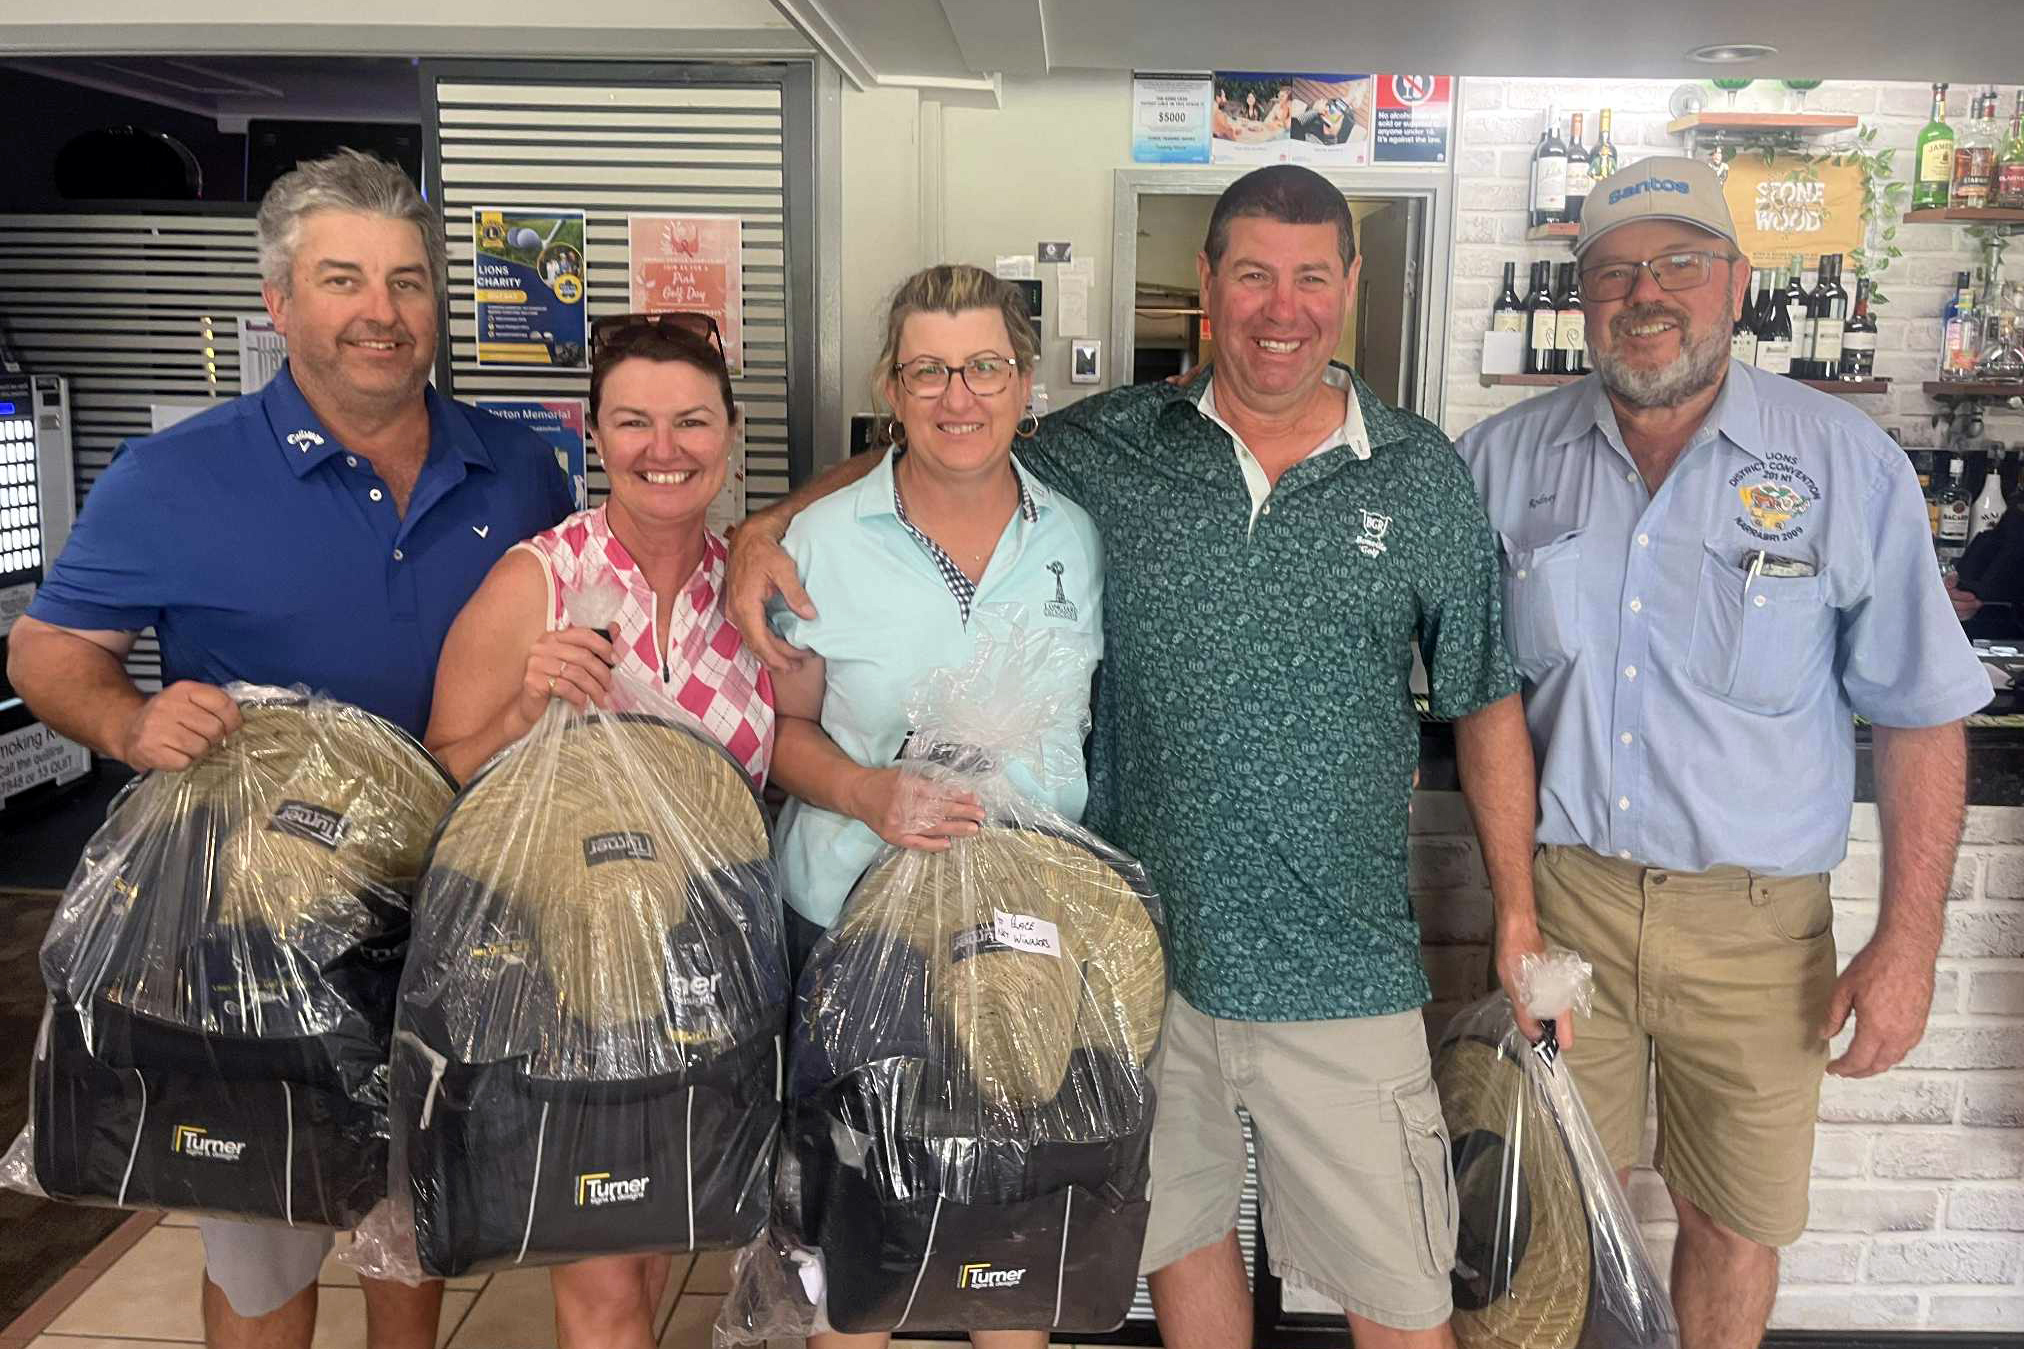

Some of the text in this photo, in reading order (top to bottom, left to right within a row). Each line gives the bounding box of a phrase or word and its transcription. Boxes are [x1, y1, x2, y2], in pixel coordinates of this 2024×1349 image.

[1158, 112, 1186, 123] $5000
[1377, 112, 1389, 120] No
[1377, 128, 1402, 137] anyone
[1403, 128, 1424, 136] under
[1388, 136, 1415, 145] against
[1608, 177, 1689, 205] santos
[1755, 182, 1824, 204] STONE
[1755, 206, 1823, 231] WOOD
[478, 265, 509, 276] LIONS
[476, 277, 521, 288] CHARITY
[673, 272, 696, 285] Pink
[662, 285, 707, 303] Golf Day
[489, 409, 572, 420] orton Memorial
[1766, 452, 1799, 466] LIONS
[1729, 461, 1821, 500] DISTRICT CONVENTION
[1763, 471, 1778, 481] 201
[1781, 526, 1804, 541] 2009
[0, 731, 43, 759] moking
[278, 809, 335, 840] Turner
[589, 836, 646, 855] Turner
[671, 972, 722, 996] ner
[183, 1131, 247, 1155] Turner
[586, 1176, 650, 1198] Turner
[968, 1268, 1026, 1283] Turner
